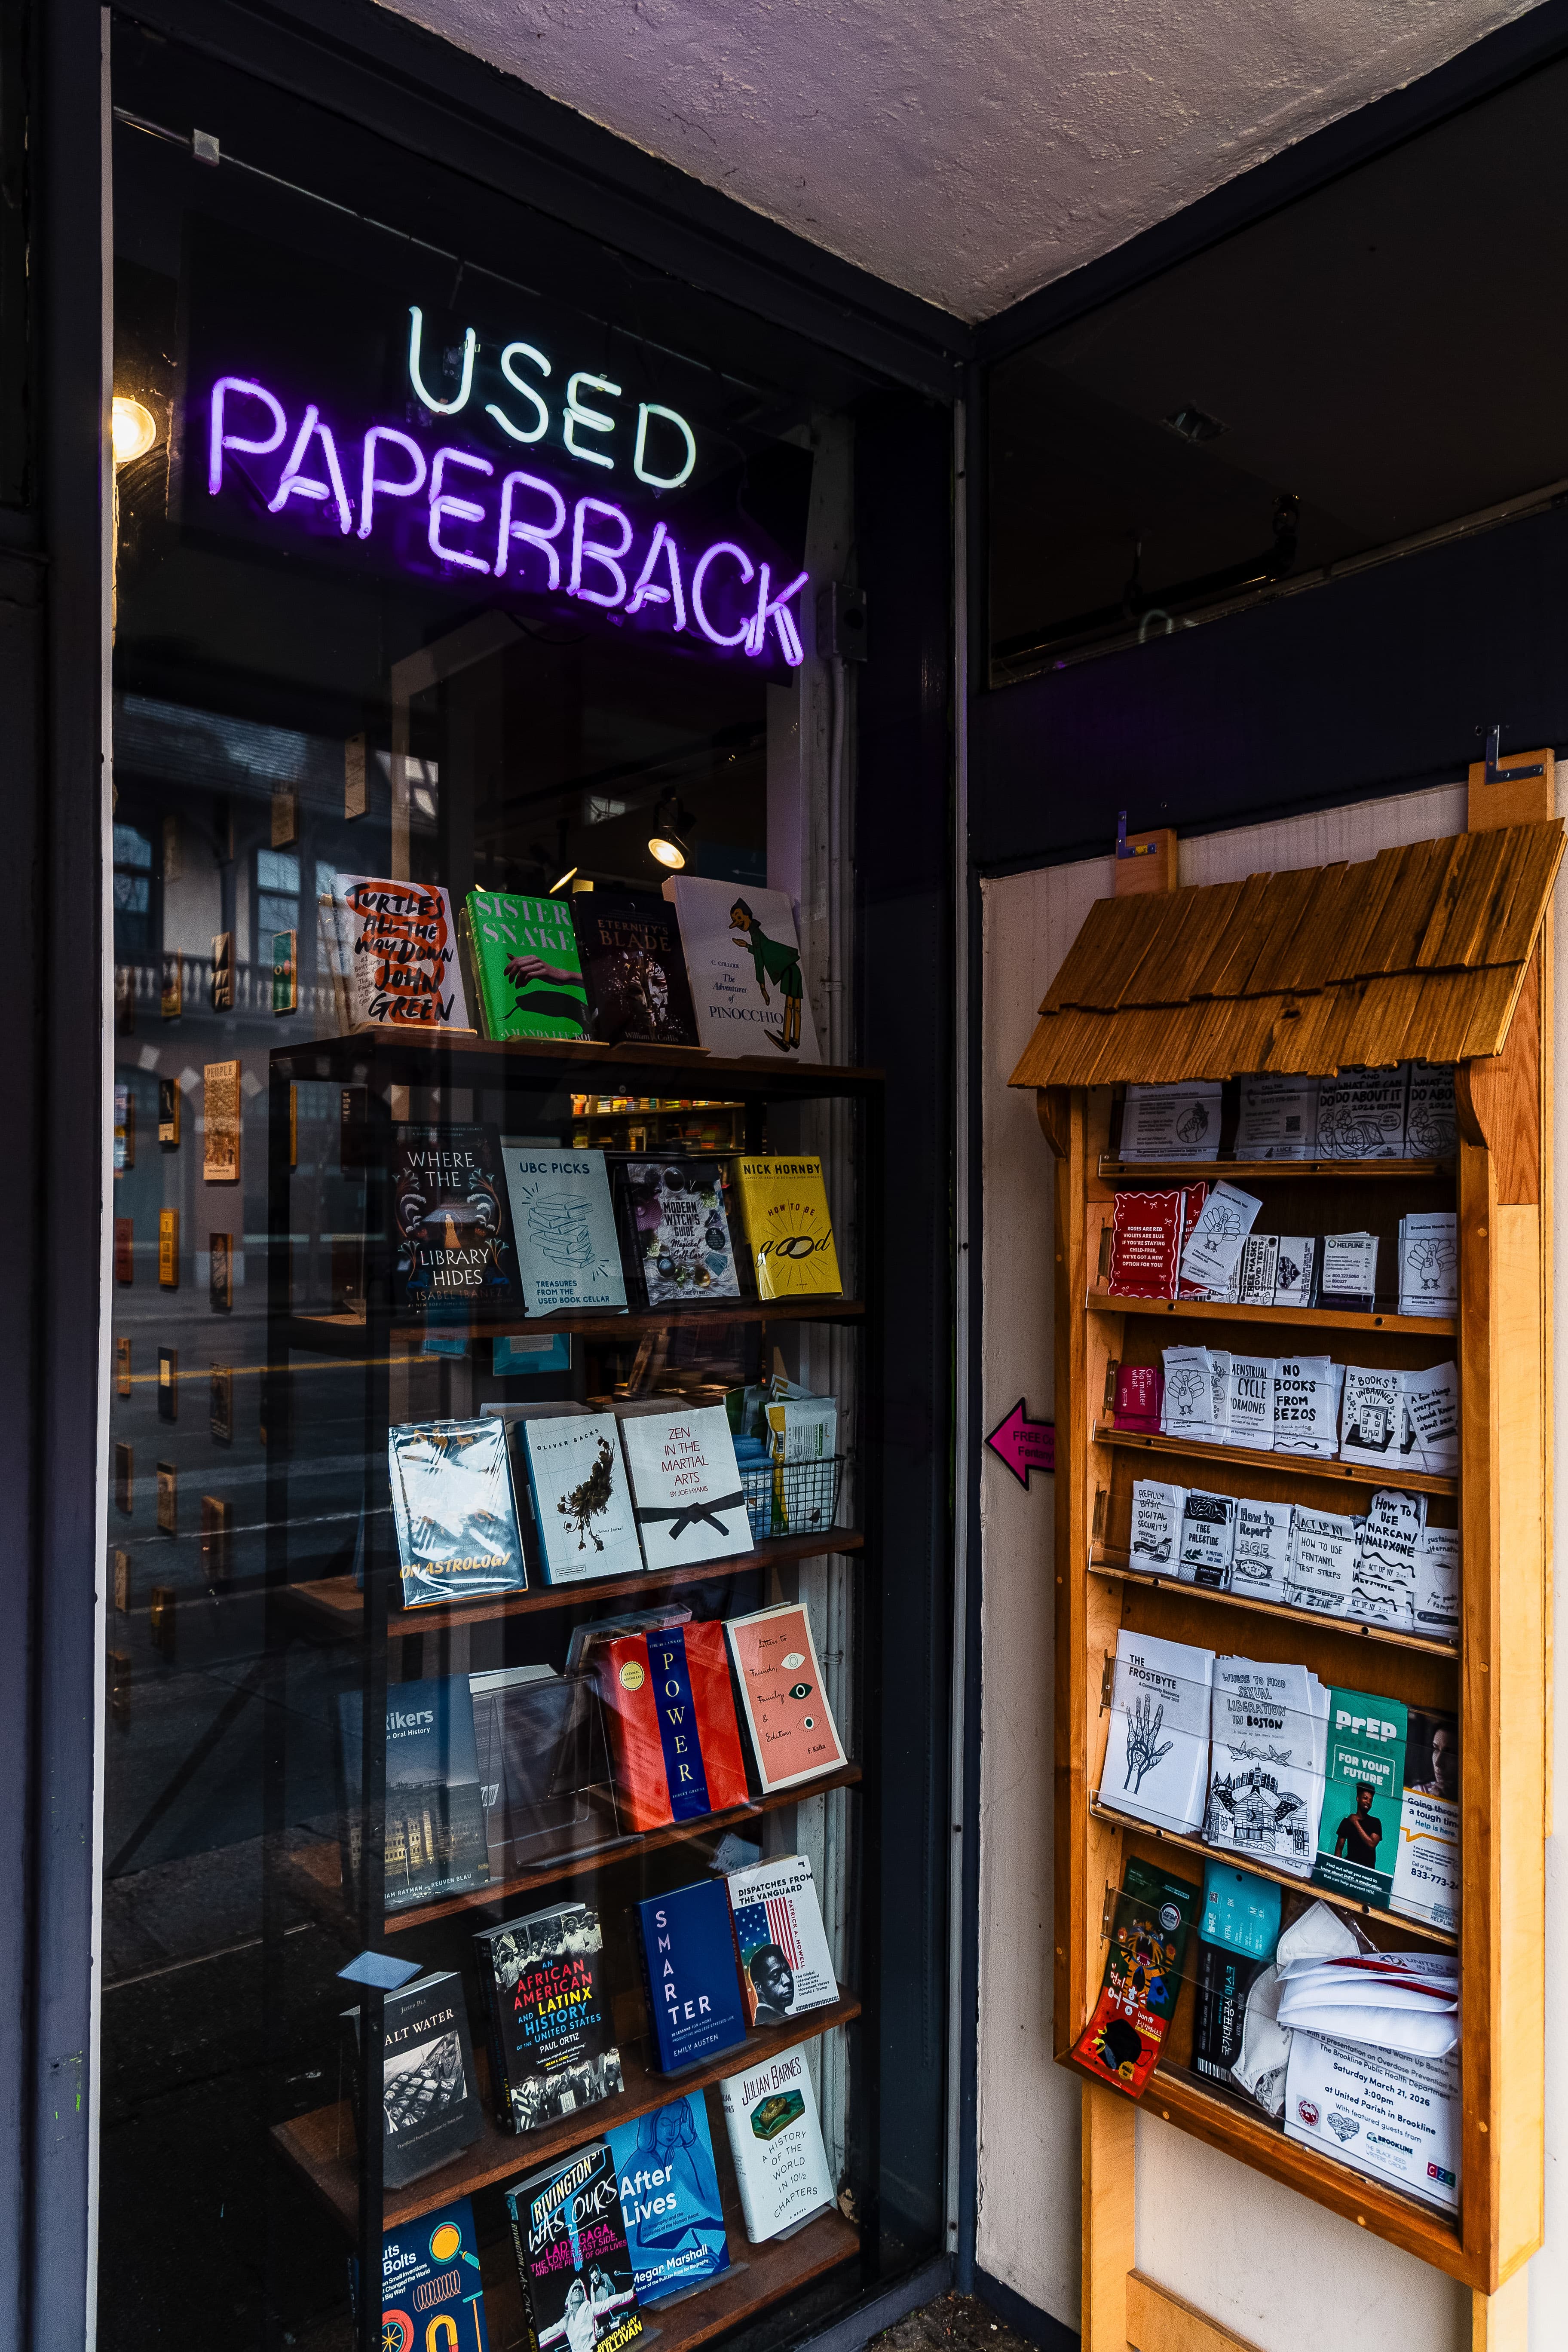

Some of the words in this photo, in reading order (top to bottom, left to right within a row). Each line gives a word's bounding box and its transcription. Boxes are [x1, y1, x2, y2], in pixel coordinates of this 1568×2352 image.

[409, 305, 696, 489] USED
[208, 376, 809, 666] PAPERBACK
[345, 883, 444, 920] TURTLES
[475, 896, 572, 927] SISTER
[363, 914, 399, 936] ALL
[402, 920, 438, 940] THE
[597, 919, 668, 935] ETERNITY'S
[483, 923, 575, 952] SNAKE
[599, 930, 671, 952] BLADE
[397, 937, 454, 965] DOWN
[374, 959, 441, 995] JOHN
[368, 993, 455, 1023] GREEN
[708, 1005, 784, 1024] PINOCCHIO
[1336, 1091, 1350, 1102] DO
[1352, 1090, 1390, 1102] ABOUT
[1391, 1089, 1402, 1100] IT
[407, 1152, 475, 1168] WHERE
[520, 1162, 547, 1173] UBC
[552, 1163, 590, 1174] PICKS
[744, 1164, 771, 1175] NICK
[775, 1164, 821, 1174] HORNBY
[425, 1172, 461, 1187] THE
[664, 1201, 697, 1213] MODERN
[665, 1213, 700, 1226] WITCH'S
[420, 1249, 490, 1265] LIBRARY
[755, 1229, 832, 1268] good
[433, 1270, 483, 1286] HIDES
[1139, 1370, 1145, 1378] No
[1283, 1364, 1300, 1377] NO
[1238, 1378, 1266, 1399] CYCLE
[1274, 1378, 1316, 1393] BOOKS
[1358, 1376, 1390, 1388] BOOKS
[1277, 1396, 1308, 1406] FROM
[1356, 1387, 1394, 1404] UNBANNED
[1275, 1408, 1316, 1421] BEZOS
[1413, 1399, 1441, 1413] everyone
[537, 1440, 569, 1451] OLIVER
[574, 1428, 599, 1443] SACKS
[668, 1427, 690, 1440] ZEN
[664, 1444, 676, 1456] IN
[678, 1440, 700, 1454] THE
[662, 1456, 709, 1472] MARTIAL
[674, 1472, 700, 1486] ARTS
[1138, 1489, 1164, 1501] REALLY
[1138, 1511, 1167, 1520] DIGITAL
[1240, 1507, 1261, 1521] How
[1264, 1510, 1274, 1525] to
[1381, 1511, 1398, 1525] USE
[1138, 1521, 1167, 1531] SECURITY
[1196, 1523, 1210, 1534] FREE
[1239, 1522, 1272, 1538] Report
[1367, 1522, 1418, 1544] NARCAN/
[1241, 1540, 1269, 1556] ICE
[1365, 1536, 1415, 1558] NALOXONE
[425, 1553, 511, 1574] ASTROLOGY
[1302, 1552, 1334, 1567] FENTANYL
[1130, 1654, 1145, 1666] THE
[750, 1665, 778, 1678] Friends,
[1129, 1667, 1176, 1689] FROSTBYTE
[1222, 1673, 1250, 1684] WHERE
[1253, 1675, 1264, 1684] TO
[1266, 1676, 1286, 1688] FIND
[757, 1693, 785, 1704] Family,
[1238, 1686, 1272, 1700] SEXUAL
[663, 1653, 693, 1782] POWER
[1227, 1700, 1286, 1717] LIBERATION
[1232, 1715, 1243, 1725] IN
[1247, 1715, 1283, 1730] BOSTON
[1335, 1710, 1397, 1742] PrEP
[766, 1730, 792, 1742] Editors
[1338, 1752, 1359, 1767] FOR
[1361, 1758, 1390, 1775] YOUR
[1343, 1767, 1383, 1785] FUTURE
[398, 1885, 423, 1896] RAYMAN
[432, 1877, 454, 1888] REUVEN
[456, 1873, 471, 1883] BLAU
[738, 1879, 787, 1897] DISPATCHES
[789, 1872, 813, 1884] FROM
[739, 1895, 755, 1905] THE
[757, 1883, 802, 1900] VANGUARD
[542, 1960, 553, 1968] AN
[518, 1959, 585, 1993] AFRICAN
[1110, 1972, 1126, 1988] 먼지
[1225, 1965, 1235, 1995] 마스크
[514, 1972, 592, 2010] AMERICAN
[1108, 1986, 1139, 2015] 어흥
[518, 2012, 533, 2024] AND
[539, 1987, 592, 2015] LATINX
[525, 2003, 587, 2036] HISTORY
[535, 2025, 567, 2043] UNITED
[570, 2013, 602, 2030] STATES
[540, 2041, 558, 2054] PAUL
[560, 2032, 579, 2046] ORTIZ
[674, 2045, 692, 2057] EMILY
[694, 2034, 718, 2049] AUSTEN
[743, 2073, 770, 2106] JULIAN
[772, 2056, 802, 2090] BARNES
[1333, 2063, 1368, 2083] Saturday
[1370, 2077, 1394, 2093] March
[1398, 2089, 1407, 2098] 21,
[1410, 2094, 1430, 2107] 2026
[1364, 2088, 1393, 2106] 3:00pm
[1335, 2089, 1359, 2104] United
[1361, 2099, 1385, 2116] Parish
[1388, 2111, 1395, 2119] in
[1398, 2114, 1436, 2135] Brookline
[763, 2154, 768, 2163] A
[769, 2131, 806, 2153] HISTORY
[772, 2153, 782, 2166] OF
[785, 2144, 802, 2156] THE
[773, 2157, 805, 2180] WORLD
[533, 2159, 592, 2224] RIVINGTON
[620, 2164, 673, 2200] After
[529, 2213, 563, 2251] WAS
[573, 2173, 617, 2221] OURS
[622, 2192, 677, 2227] Lives
[774, 2187, 818, 2218] CHAPTERS
[383, 2253, 416, 2276] Bolts
